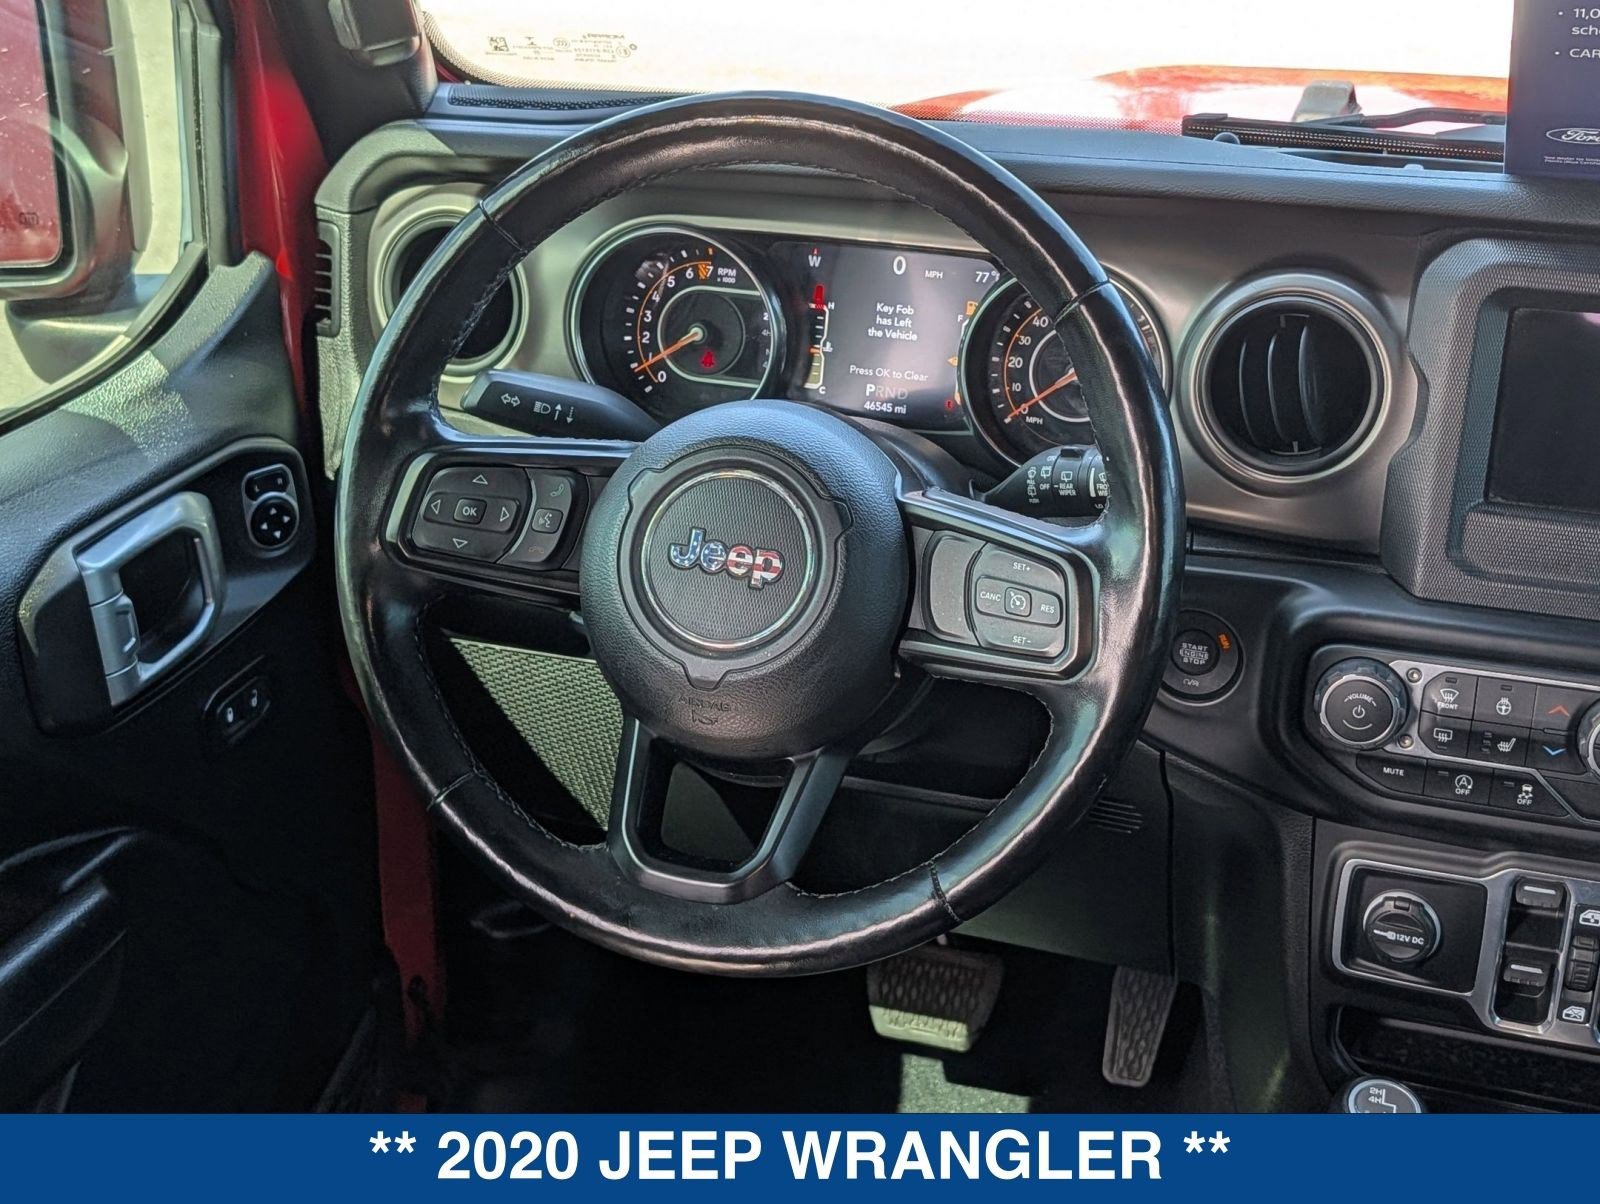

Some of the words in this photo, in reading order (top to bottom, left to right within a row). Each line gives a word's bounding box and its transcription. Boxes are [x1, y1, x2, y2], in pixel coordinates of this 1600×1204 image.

[1571, 25, 1600, 35] sch
[808, 255, 821, 268] W
[893, 255, 906, 275] 0
[685, 267, 694, 279] 6
[706, 265, 714, 277] 7
[717, 267, 737, 276] RPM
[925, 270, 943, 279] MPH
[667, 275, 676, 287] 5
[651, 291, 660, 303] 4
[876, 302, 893, 314] Key
[896, 303, 914, 315] Fob
[644, 310, 652, 322] 3
[876, 315, 892, 326] has
[894, 316, 912, 327] Left
[1033, 315, 1049, 328] 40
[641, 331, 650, 344] 2
[868, 327, 883, 337] the
[885, 328, 917, 341] Vehicle
[1018, 335, 1031, 346] 30
[1008, 356, 1023, 368] 20
[657, 370, 667, 383] 0
[849, 365, 873, 377] Press
[875, 368, 890, 378] OK
[892, 370, 902, 379] to
[904, 370, 928, 382] Clear
[819, 386, 826, 394] C
[1012, 382, 1021, 392] 10
[864, 402, 893, 413] 46545
[894, 403, 907, 414] mi
[1026, 415, 1043, 425] MPH
[462, 506, 477, 516] OK
[668, 527, 785, 590] Jeep
[980, 591, 1001, 602] CANC
[1040, 604, 1055, 614] RES
[1182, 642, 1208, 651] START
[1183, 657, 1206, 665] STOP
[1348, 692, 1374, 703] VOLUME
[1437, 701, 1459, 711] FRONT
[1383, 766, 1404, 776] MUTE
[1455, 787, 1470, 796] OFF
[1516, 797, 1532, 806] OFF
[1396, 933, 1411, 943] 12V
[1412, 935, 1424, 945] DC
[1370, 1086, 1382, 1095] 2H
[1368, 1095, 1382, 1104] 4H
